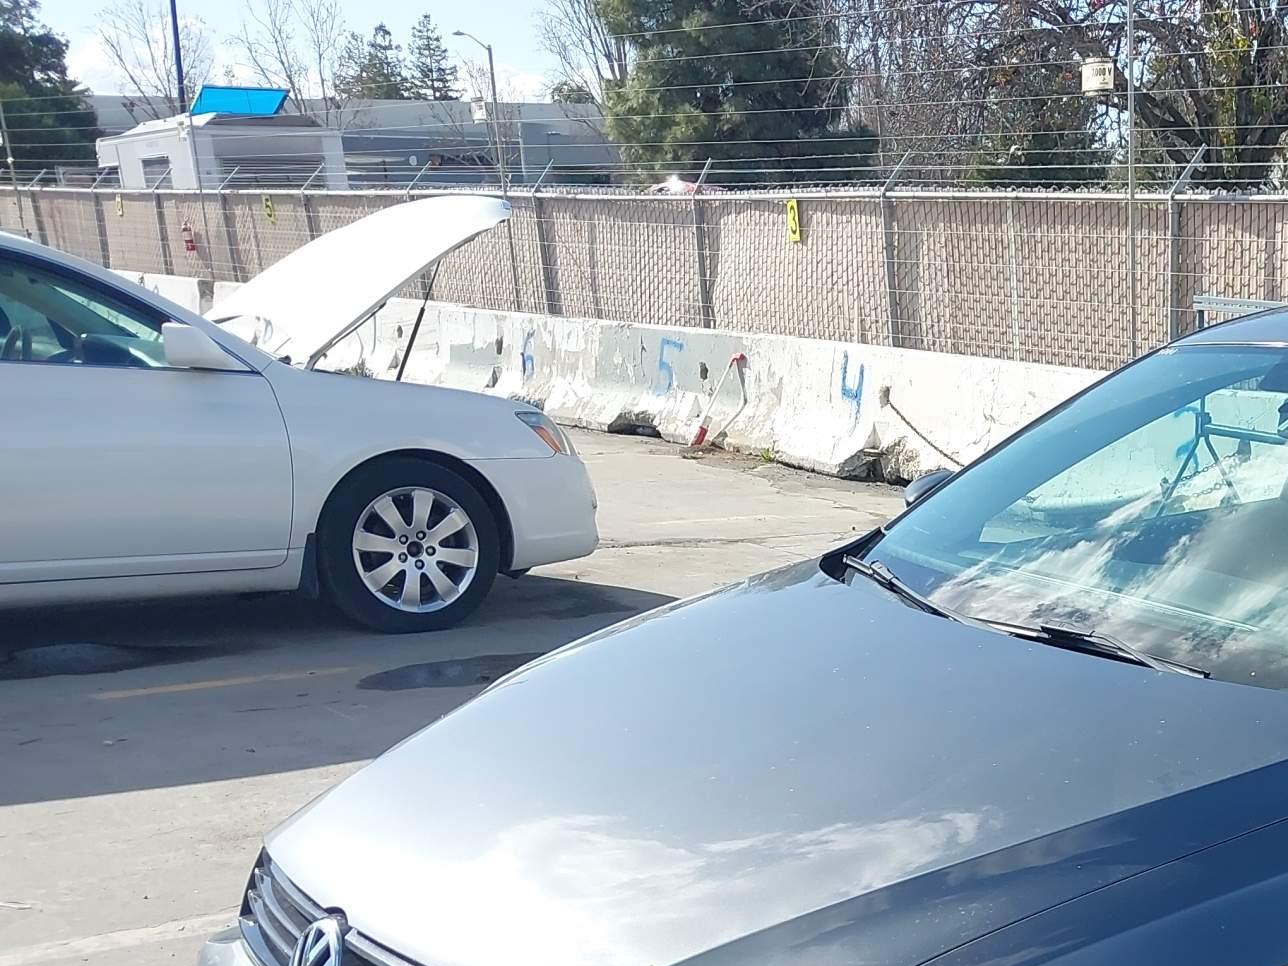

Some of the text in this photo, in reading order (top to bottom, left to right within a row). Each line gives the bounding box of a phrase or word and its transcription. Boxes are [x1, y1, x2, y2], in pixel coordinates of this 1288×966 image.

[789, 205, 798, 235] 3
[520, 328, 536, 377] 6
[655, 336, 684, 397] 5
[840, 348, 866, 434] 4
